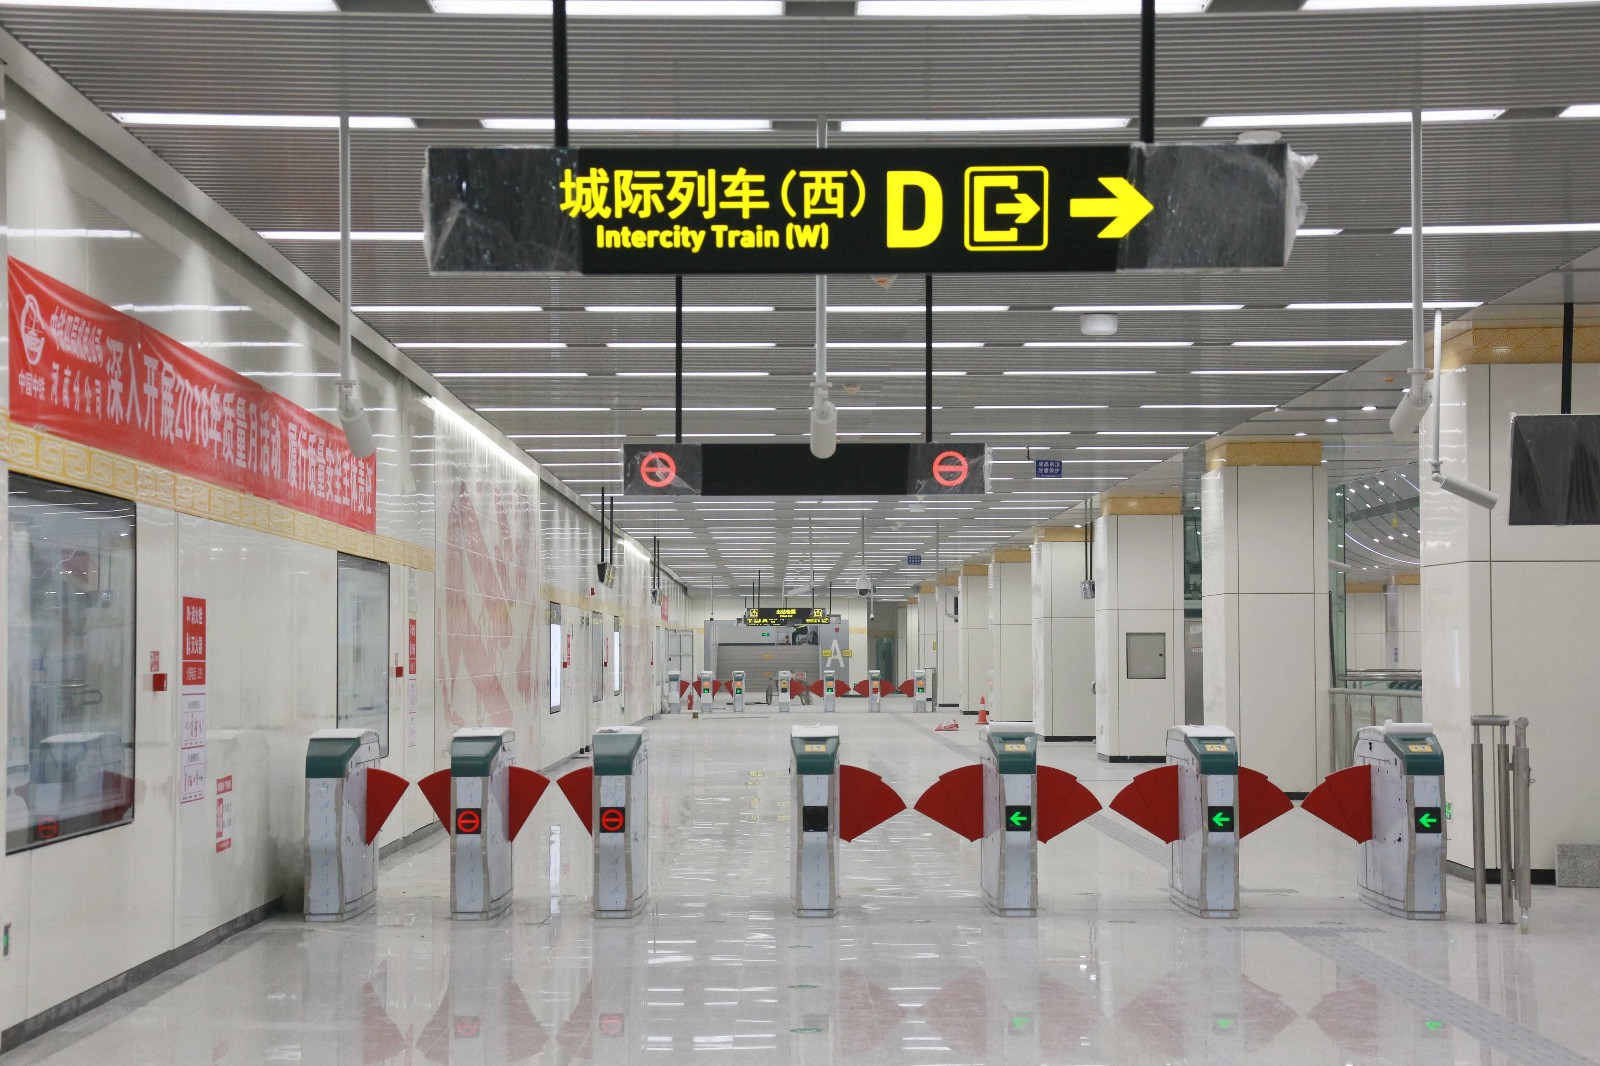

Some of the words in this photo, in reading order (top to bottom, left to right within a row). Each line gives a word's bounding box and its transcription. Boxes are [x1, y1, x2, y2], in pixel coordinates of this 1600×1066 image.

[886, 171, 943, 249] D
[597, 225, 706, 253] Intercity
[711, 225, 779, 248] Train
[786, 222, 829, 250] (W)
[18, 368, 45, 401] 中国中铁
[825, 640, 845, 667] A
